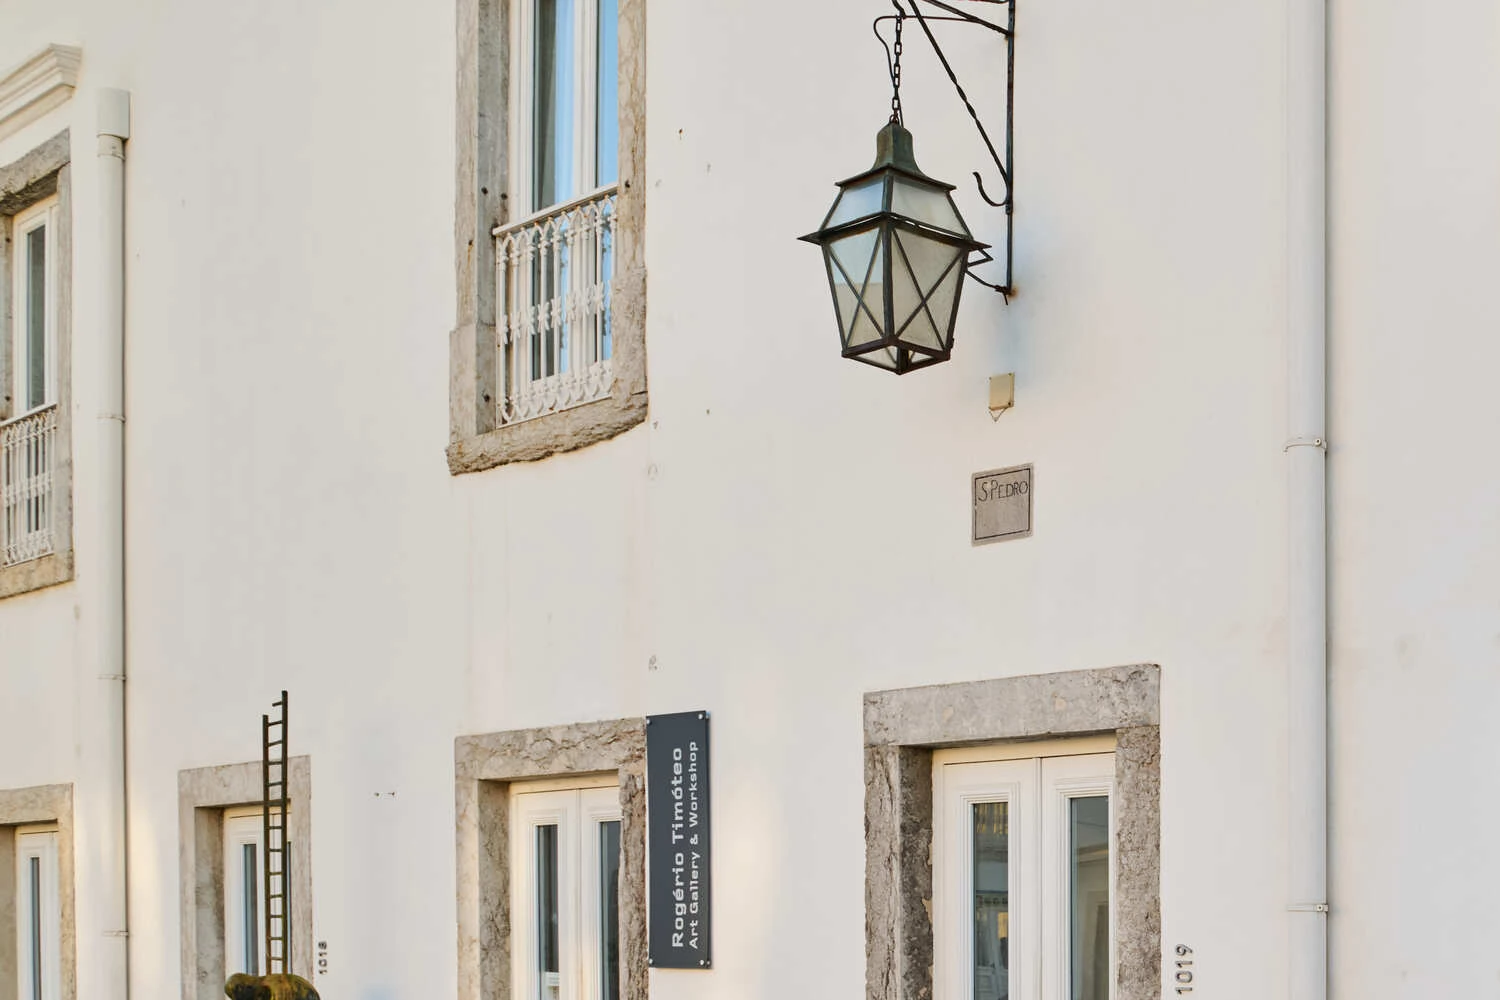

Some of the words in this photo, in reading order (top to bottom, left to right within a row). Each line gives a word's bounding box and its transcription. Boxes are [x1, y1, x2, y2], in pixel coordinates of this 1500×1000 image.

[671, 747, 684, 845] Timóteo
[687, 741, 699, 828] Workshop
[689, 833, 699, 846] &
[671, 852, 687, 948] Rogério
[689, 851, 701, 915] Gallery
[688, 919, 699, 950] Art
[1175, 943, 1193, 995] 1019
